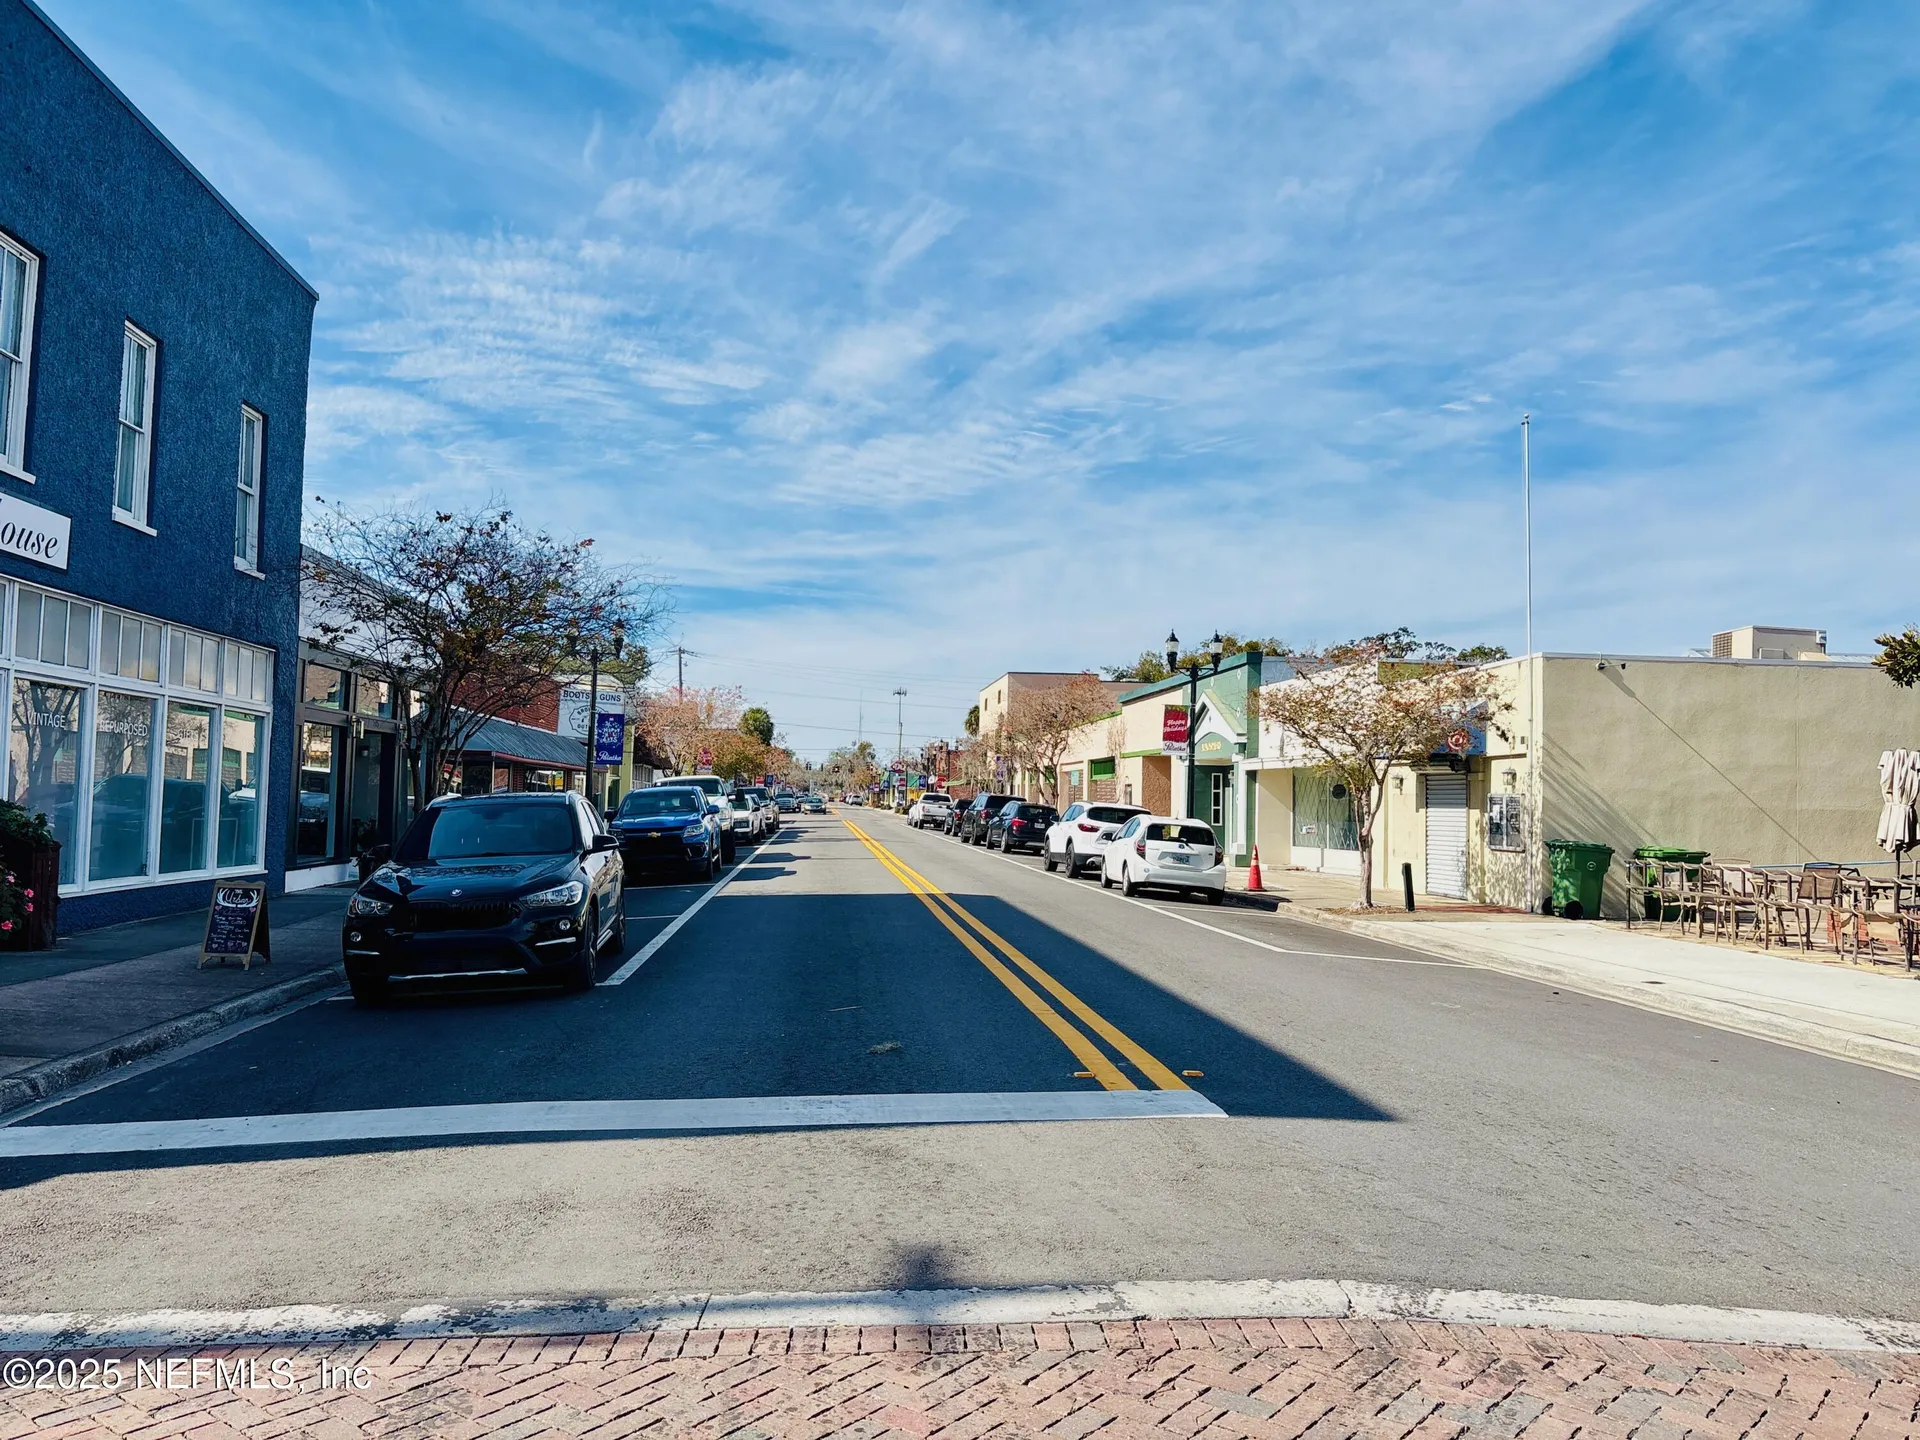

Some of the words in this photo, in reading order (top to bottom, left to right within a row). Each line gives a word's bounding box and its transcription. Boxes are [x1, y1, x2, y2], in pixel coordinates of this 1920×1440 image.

[0, 519, 61, 559] ouse
[563, 690, 590, 700] BOOTS
[600, 693, 621, 702] GUNS
[27, 711, 67, 728] VINTAGE
[100, 719, 148, 737] REPURPOSED
[1166, 719, 1186, 729] Happy
